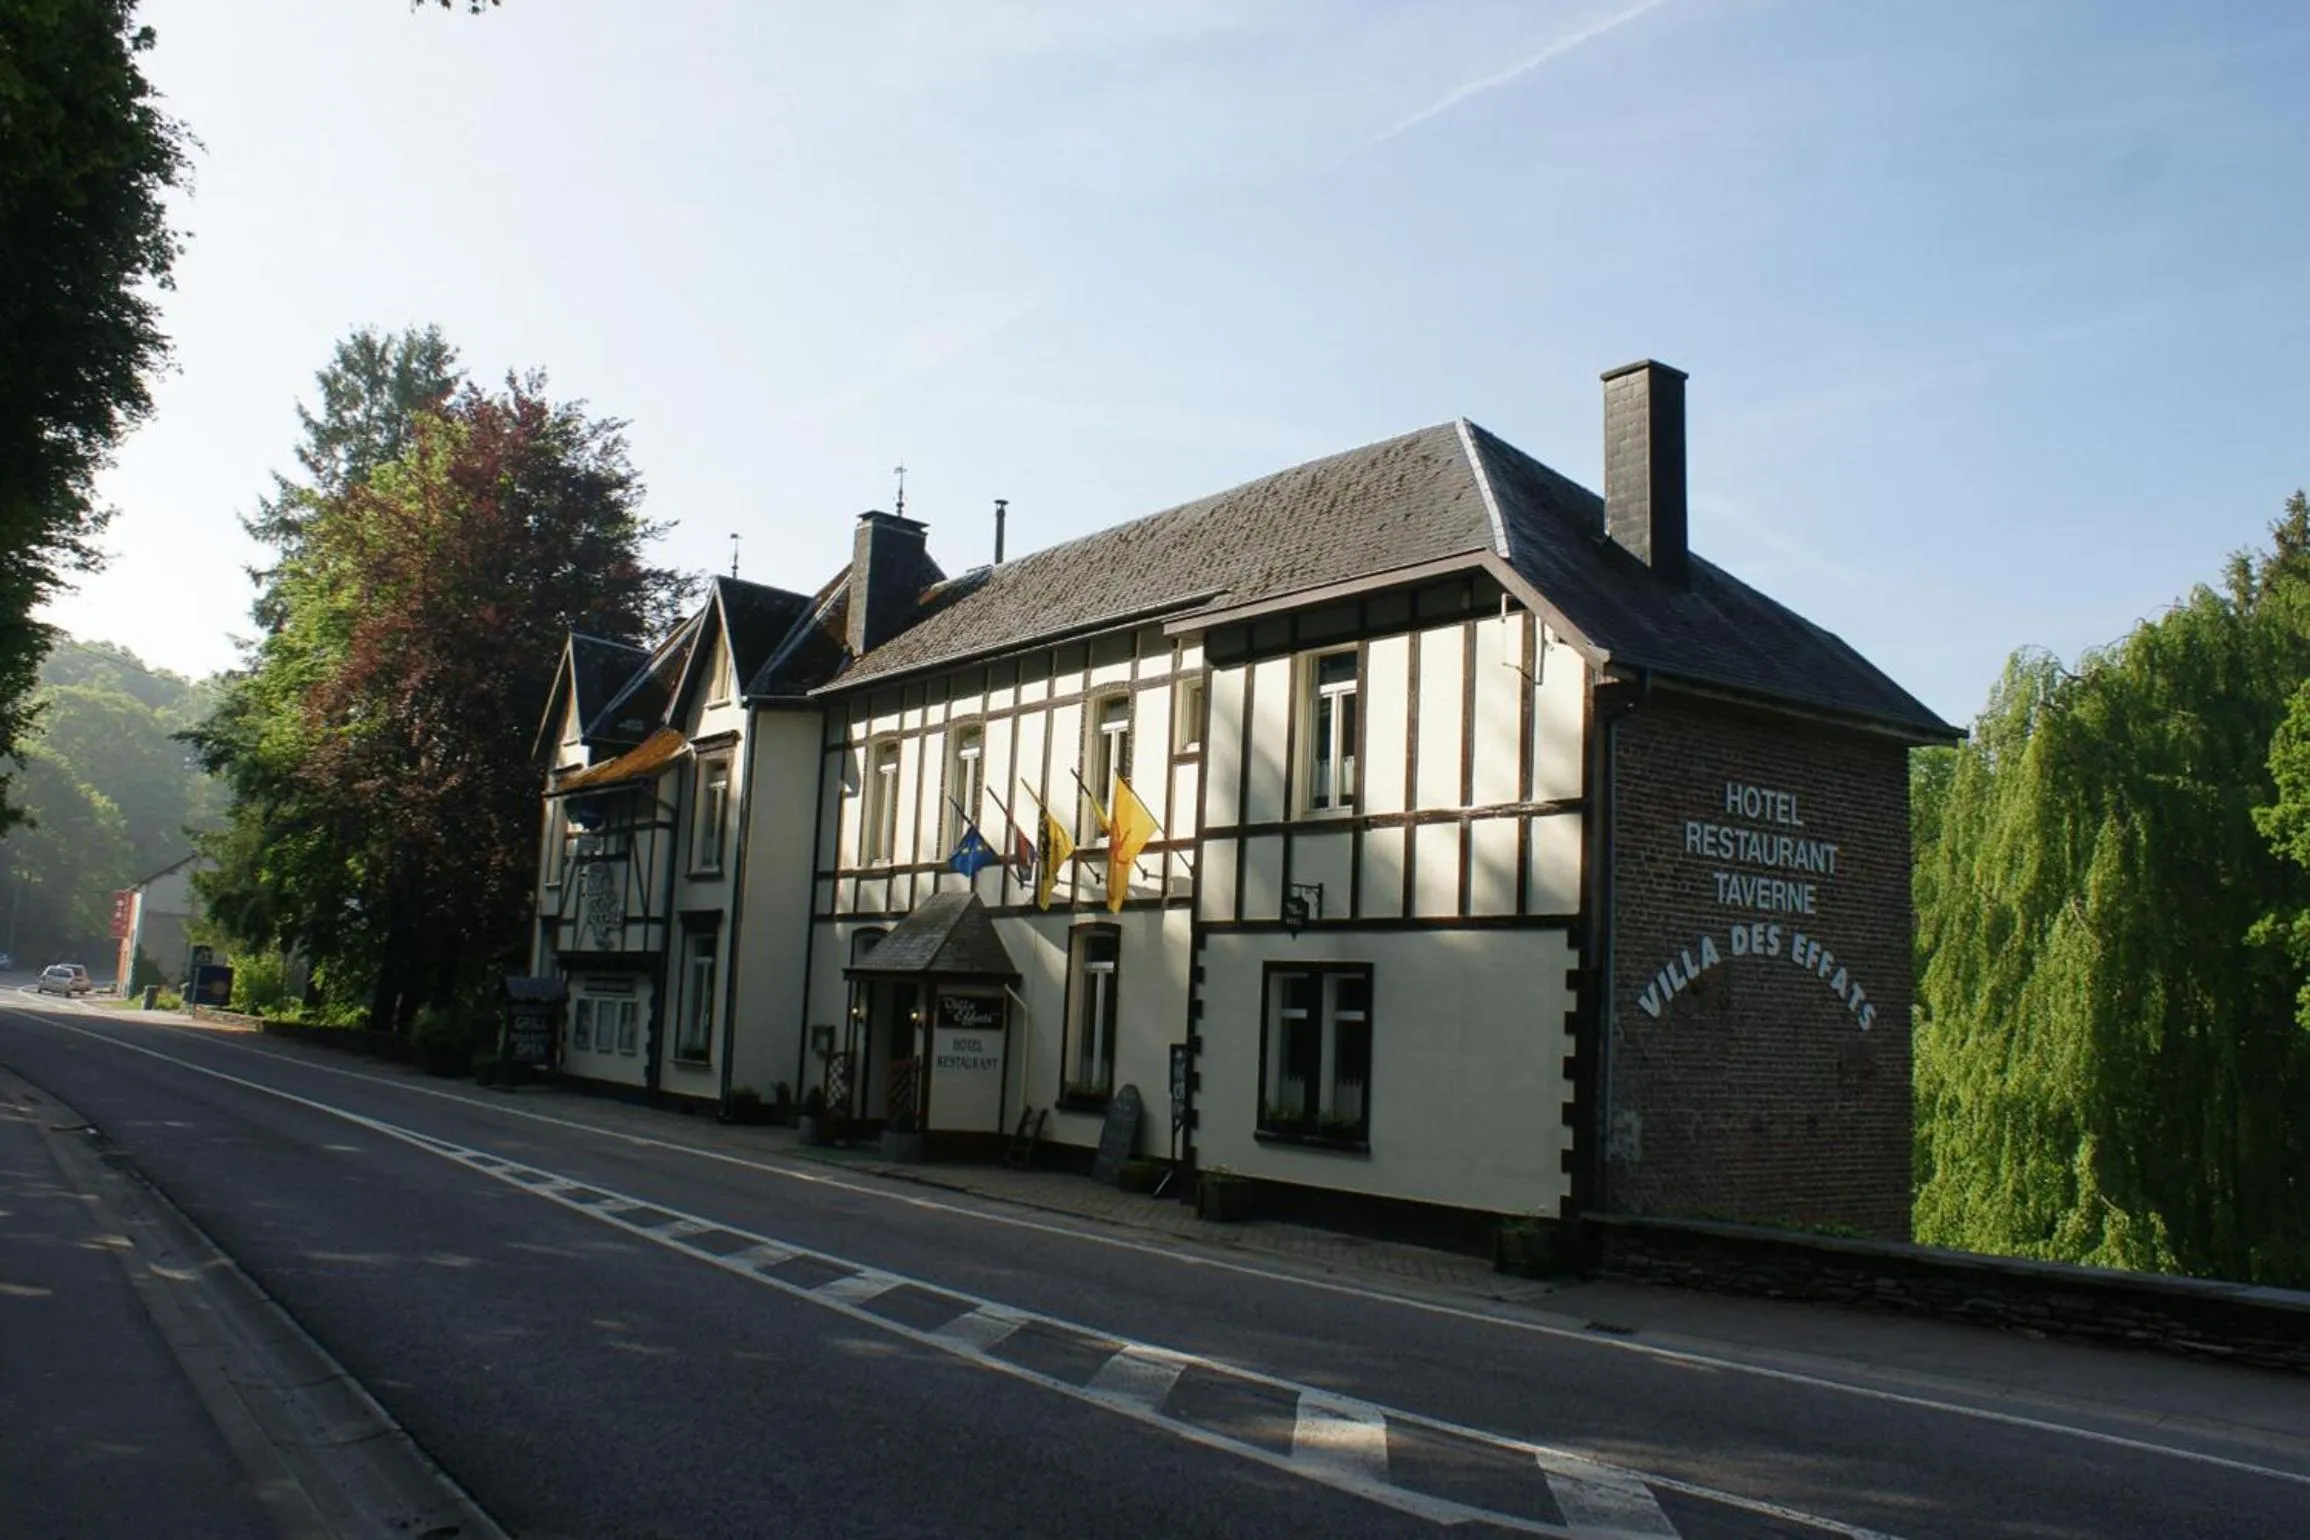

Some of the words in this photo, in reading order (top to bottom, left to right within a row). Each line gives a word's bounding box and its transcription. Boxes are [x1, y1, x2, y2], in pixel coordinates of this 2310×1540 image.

[1725, 781, 1805, 826] HOTEL
[1685, 821, 1840, 875] RESTAURANT
[1713, 871, 1818, 916] TAVERNE
[1638, 935, 1721, 1018] VILLA
[1731, 923, 1782, 957] DES
[1791, 932, 1877, 1032] EFFATS
[937, 1055, 998, 1070] RESTAURANT
[952, 1039, 983, 1052] HOTEL
